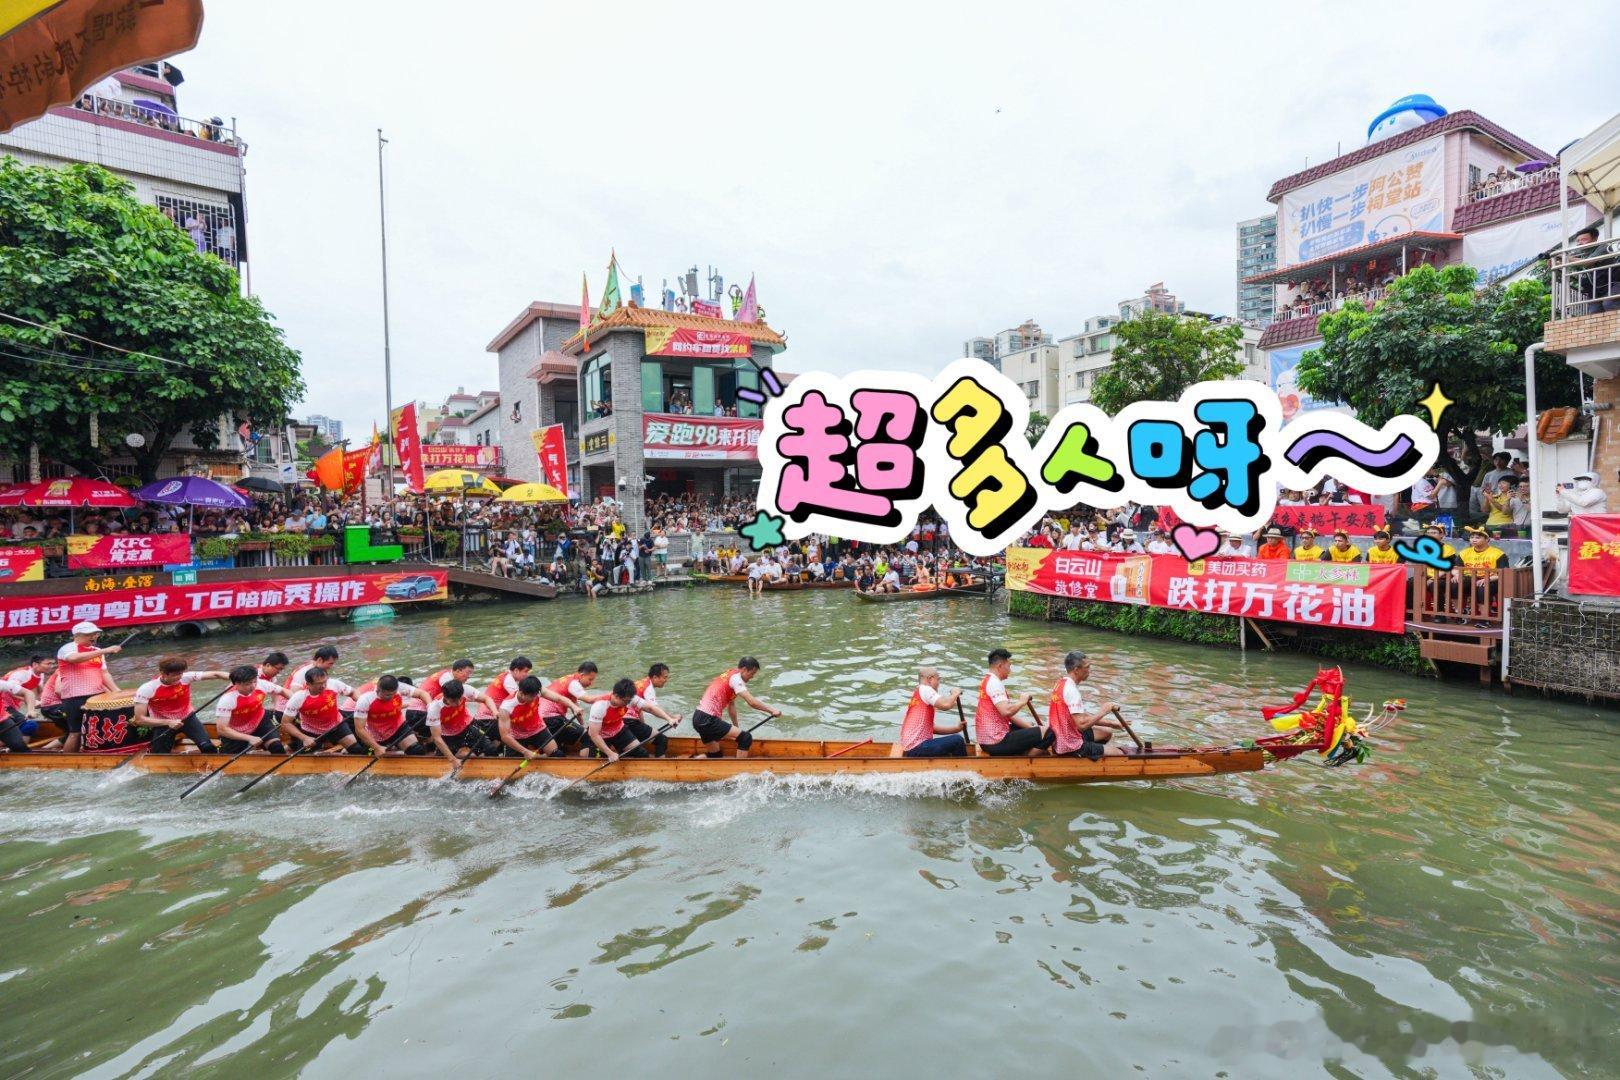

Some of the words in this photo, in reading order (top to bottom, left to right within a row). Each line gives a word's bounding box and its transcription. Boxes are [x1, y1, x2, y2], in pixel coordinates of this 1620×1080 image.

[113, 538, 152, 549] KFC
[1055, 557, 1101, 577] 白云山
[1207, 561, 1267, 577] 美团买药
[1055, 580, 1099, 599] 敬修堂
[1167, 576, 1376, 627] 跌打万花油
